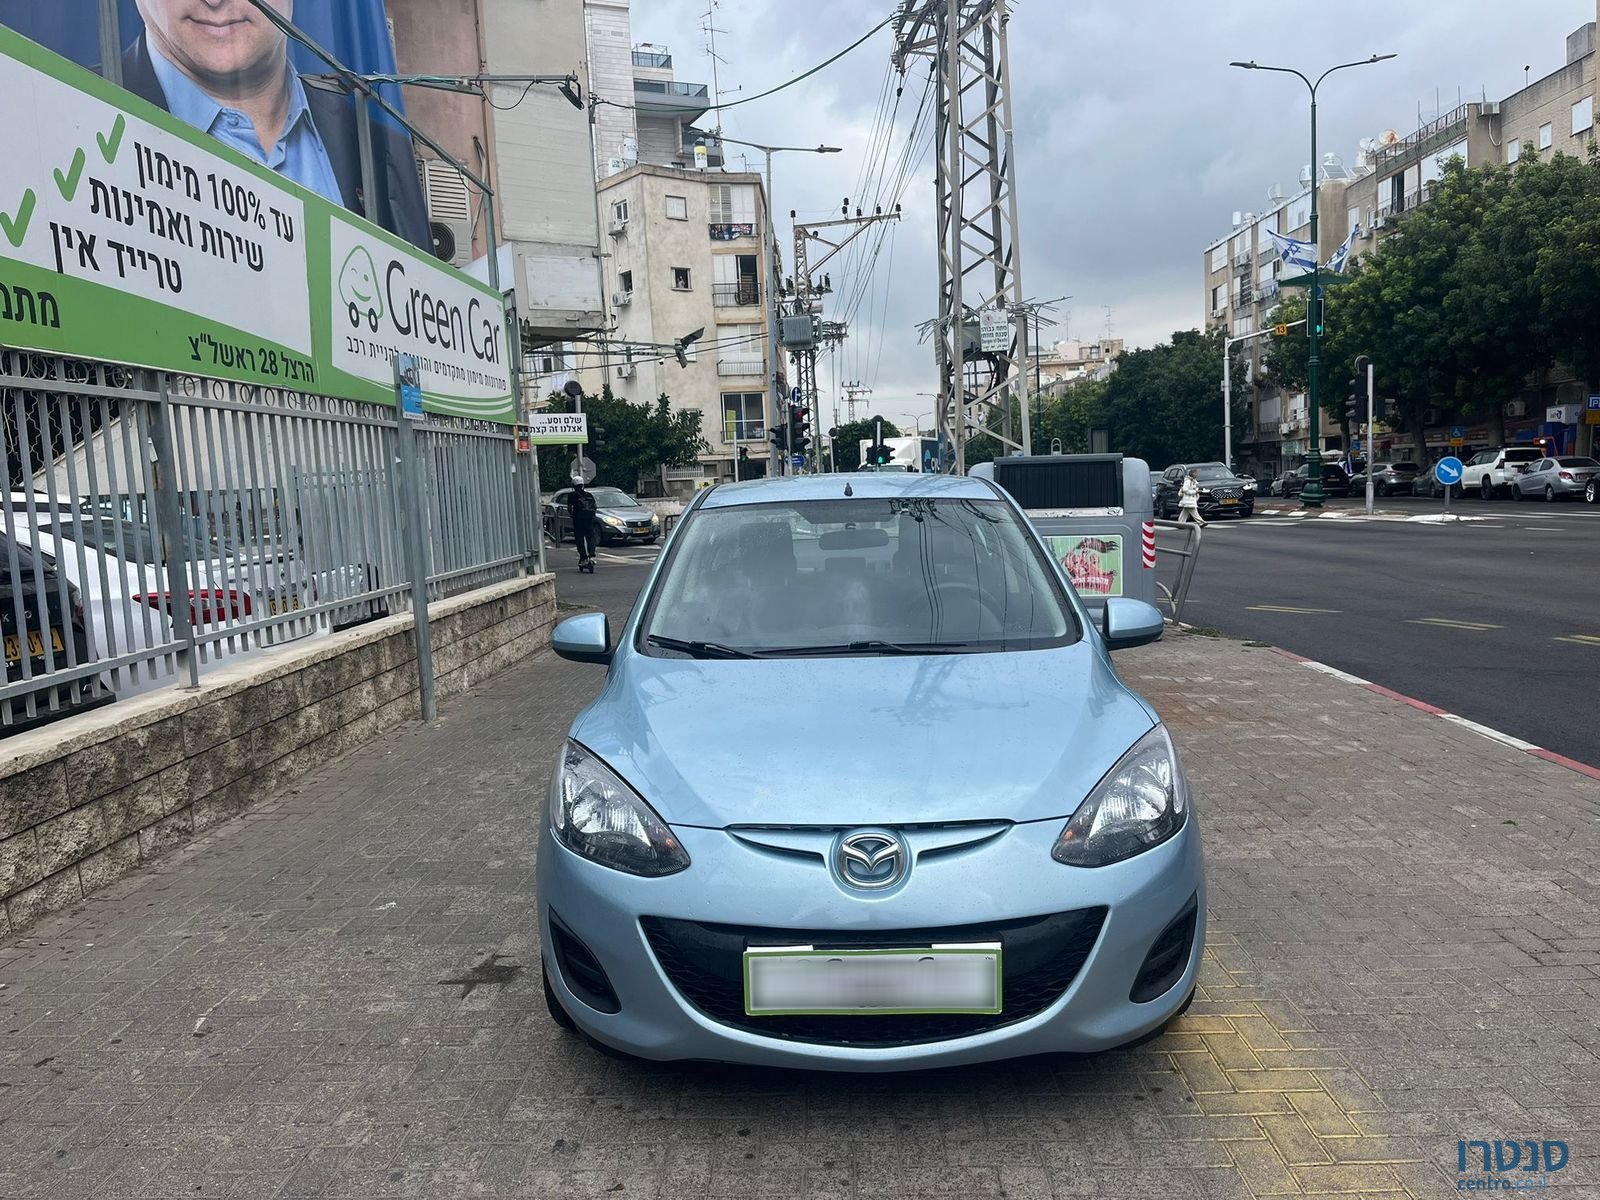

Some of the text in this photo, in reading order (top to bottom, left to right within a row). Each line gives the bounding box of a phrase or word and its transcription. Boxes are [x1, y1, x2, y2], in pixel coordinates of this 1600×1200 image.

[134, 141, 294, 243] עד 100% מימון
[89, 177, 264, 272] שירות ואמינות
[49, 221, 182, 293] טרייד אין
[386, 260, 500, 364] Green Car
[346, 336, 366, 356] רכב
[260, 348, 278, 376] 28
[280, 352, 315, 383] הרצל
[434, 360, 466, 382] מתקדמים
[466, 368, 484, 386] מימון
[529, 426, 547, 435] קצת
[560, 425, 583, 433] אצלנו
[563, 416, 582, 424] שלם
